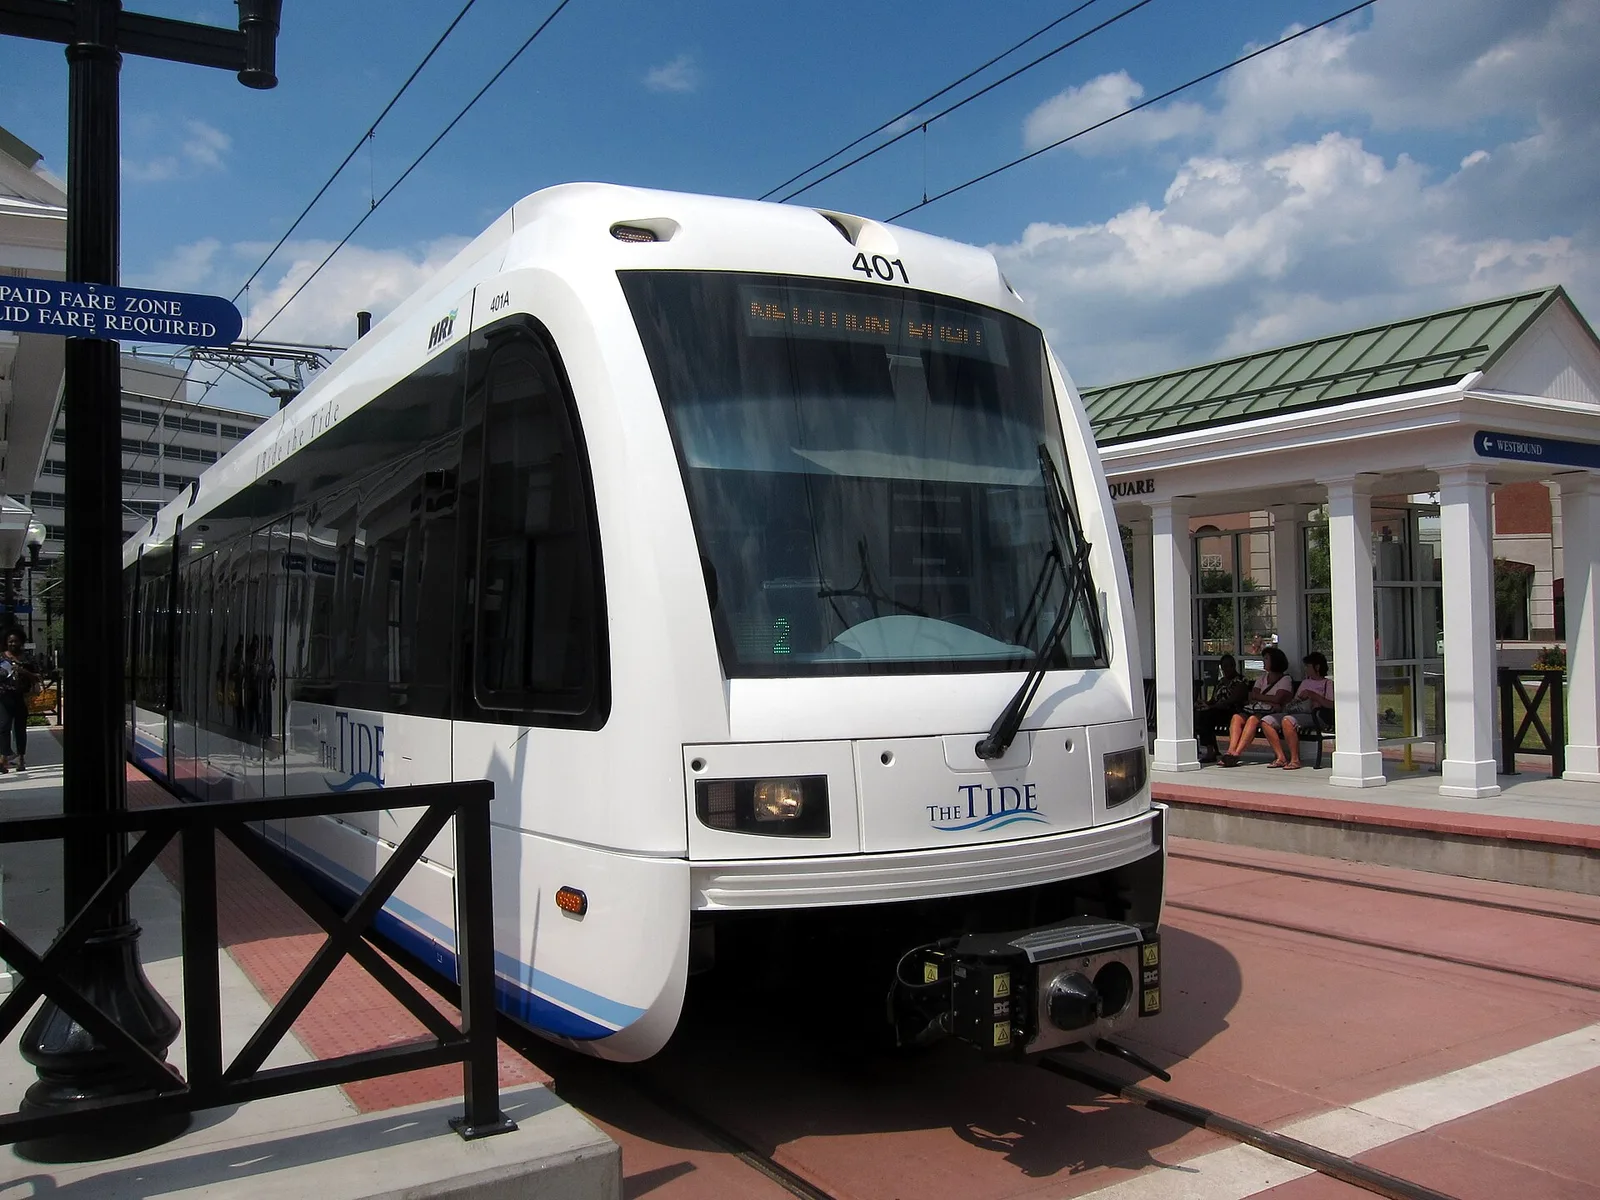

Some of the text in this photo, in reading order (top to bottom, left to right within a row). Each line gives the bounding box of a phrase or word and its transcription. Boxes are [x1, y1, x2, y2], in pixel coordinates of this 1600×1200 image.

[851, 252, 909, 285] 401
[0, 286, 182, 317] PAID FARE ZONE
[490, 290, 510, 313] 401A
[0, 306, 216, 338] ID FARE REQUIRED
[310, 399, 341, 439] Tide
[1496, 439, 1543, 455] WESTBOUND
[773, 618, 791, 654] 2
[335, 710, 386, 786] TIDE
[926, 783, 1039, 822] THE TIDE
